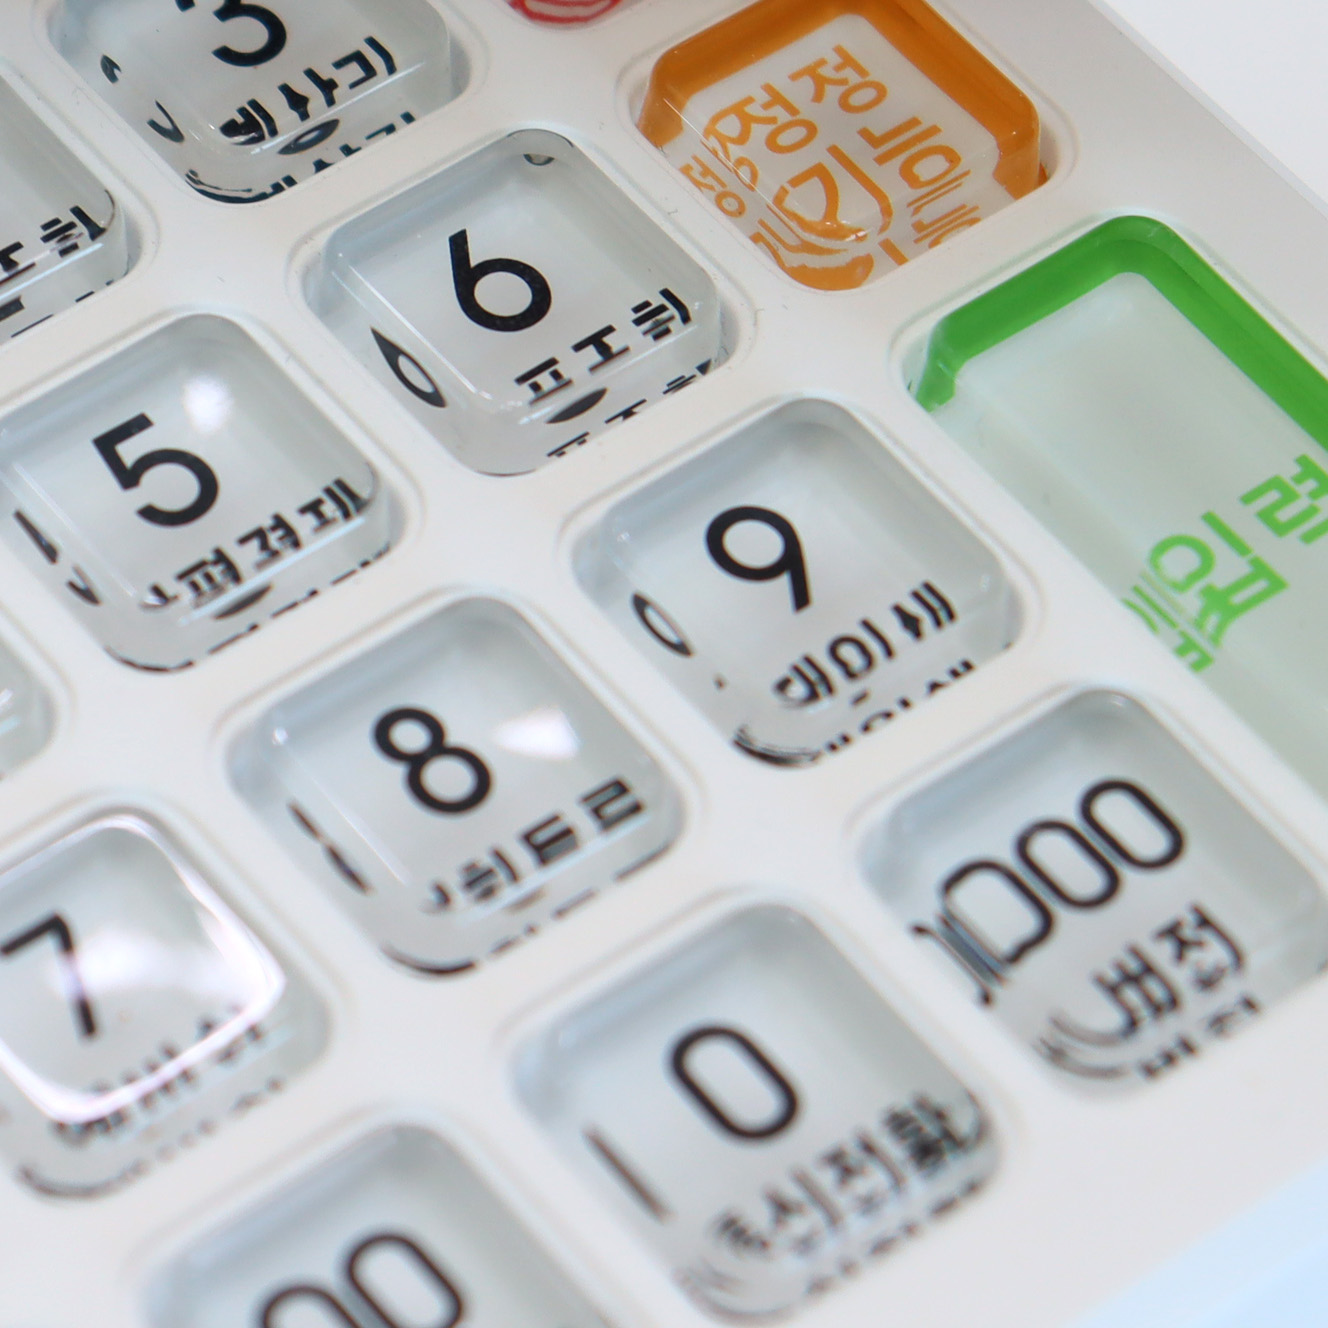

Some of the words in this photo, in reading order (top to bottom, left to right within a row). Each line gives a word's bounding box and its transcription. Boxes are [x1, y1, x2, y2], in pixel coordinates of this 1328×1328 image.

[448, 228, 552, 333] 6
[92, 412, 220, 529] 5
[705, 505, 812, 613] 9
[372, 707, 493, 815] 8
[667, 1025, 800, 1143] 0
